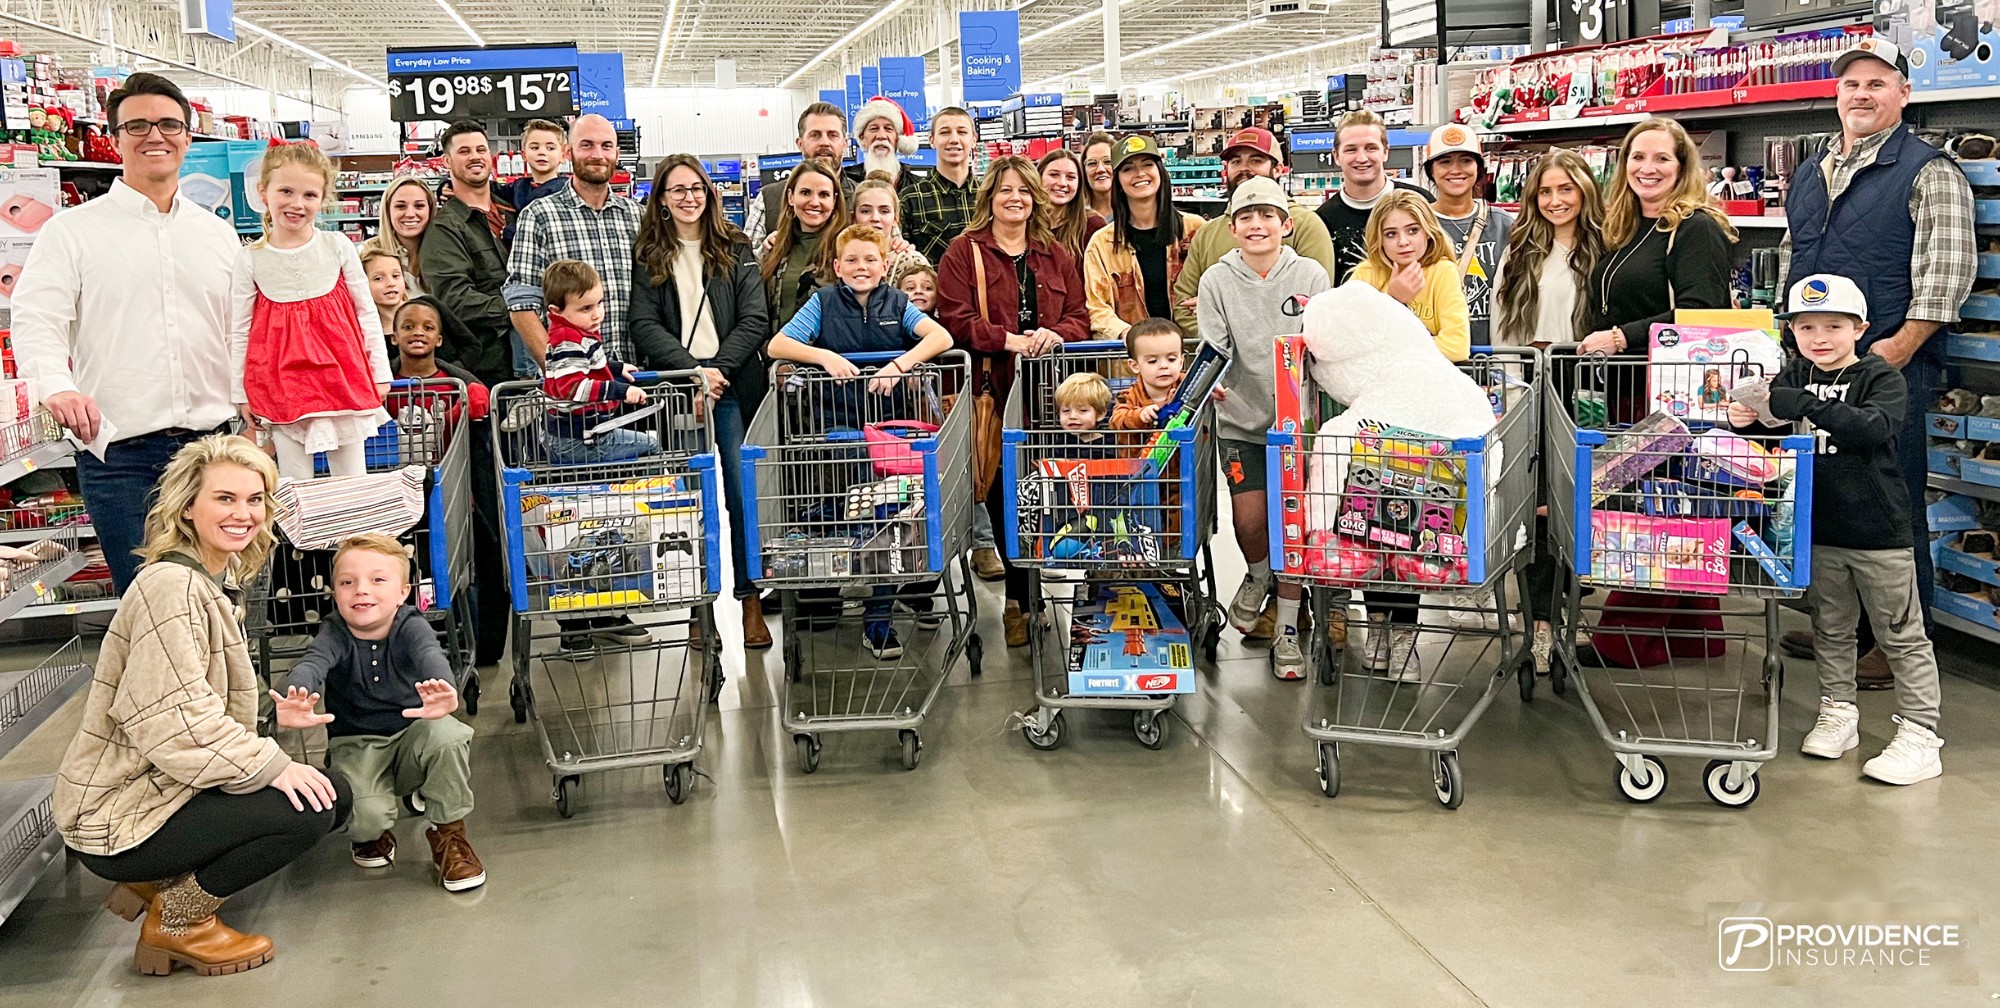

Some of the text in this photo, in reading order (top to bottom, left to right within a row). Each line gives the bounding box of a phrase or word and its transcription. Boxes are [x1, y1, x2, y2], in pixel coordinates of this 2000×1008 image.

[395, 57, 471, 67] Everyday Low Price
[966, 55, 1011, 66] Cooking &
[967, 66, 996, 77] Baking
[903, 90, 918, 98] Prep
[1035, 96, 1051, 104] H19
[1297, 138, 1325, 146] Everyday
[1340, 519, 1366, 530] OMG
[1705, 536, 1727, 576] Barbie
[1088, 678, 1119, 688] FORTNITE
[1124, 674, 1138, 691] X
